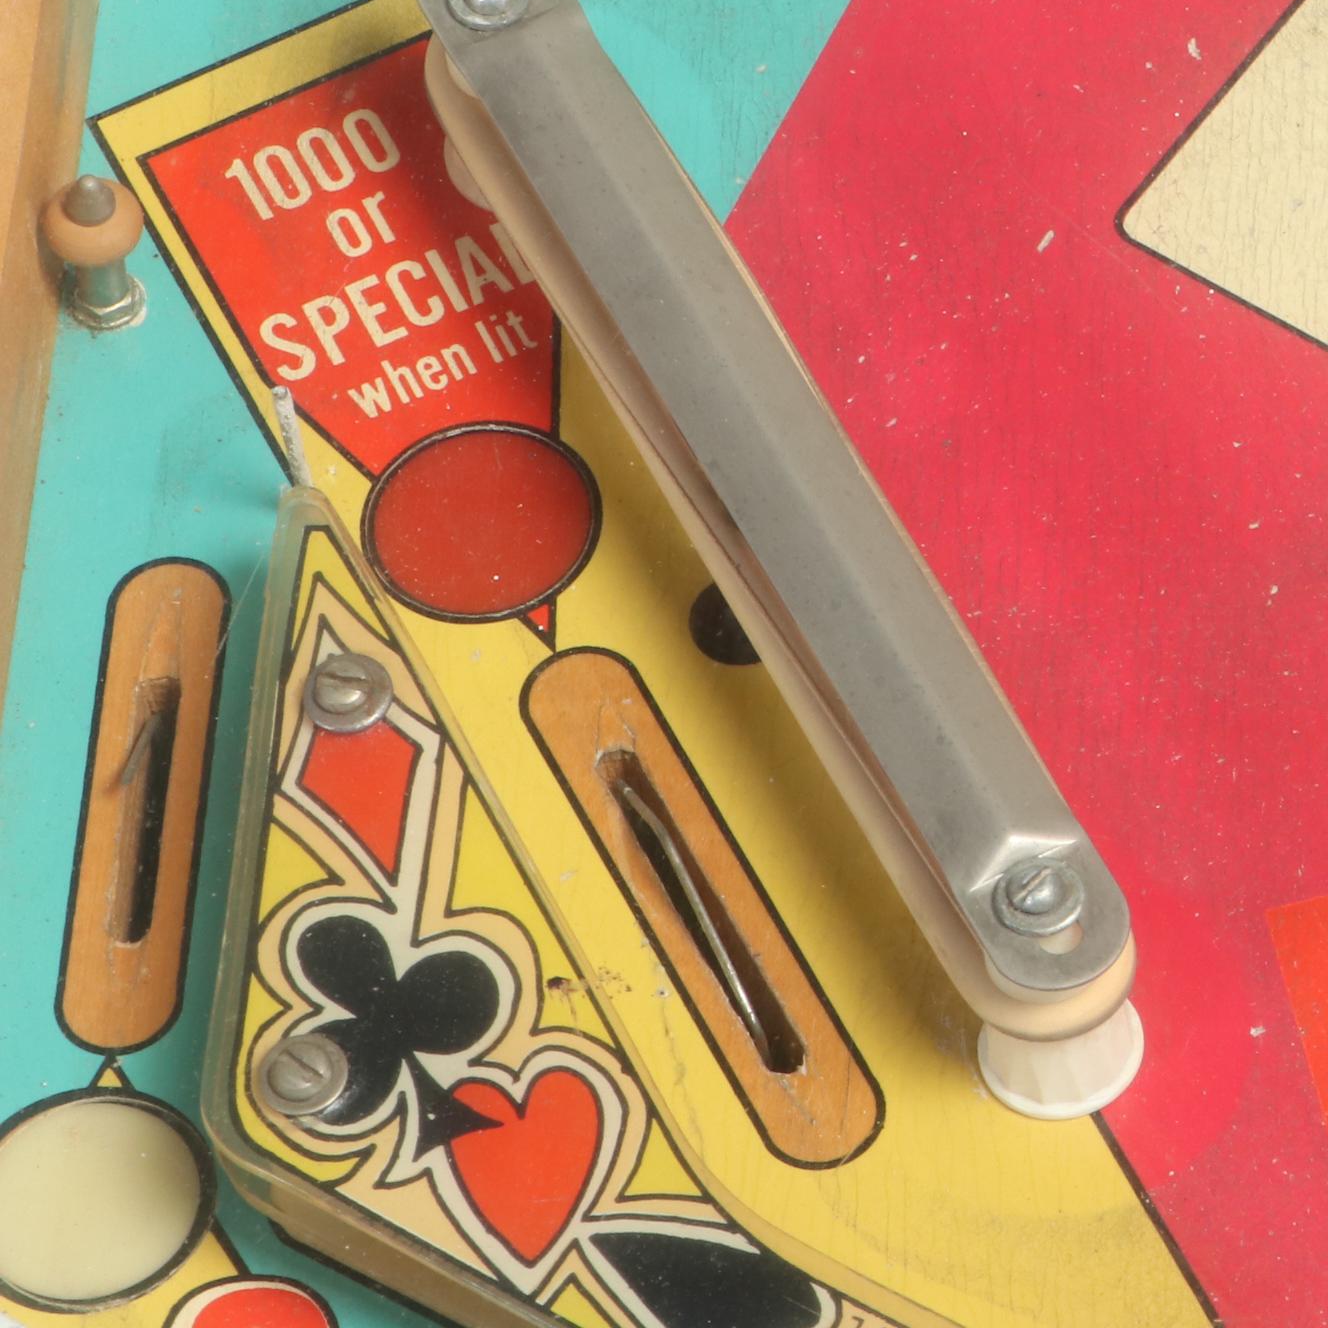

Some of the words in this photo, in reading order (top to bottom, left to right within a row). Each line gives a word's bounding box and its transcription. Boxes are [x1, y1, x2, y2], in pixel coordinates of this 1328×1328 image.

[223, 108, 401, 221] 1000
[325, 191, 397, 258] or
[258, 222, 536, 382] SPECIAL
[346, 342, 479, 419] when
[474, 308, 539, 365] lit
